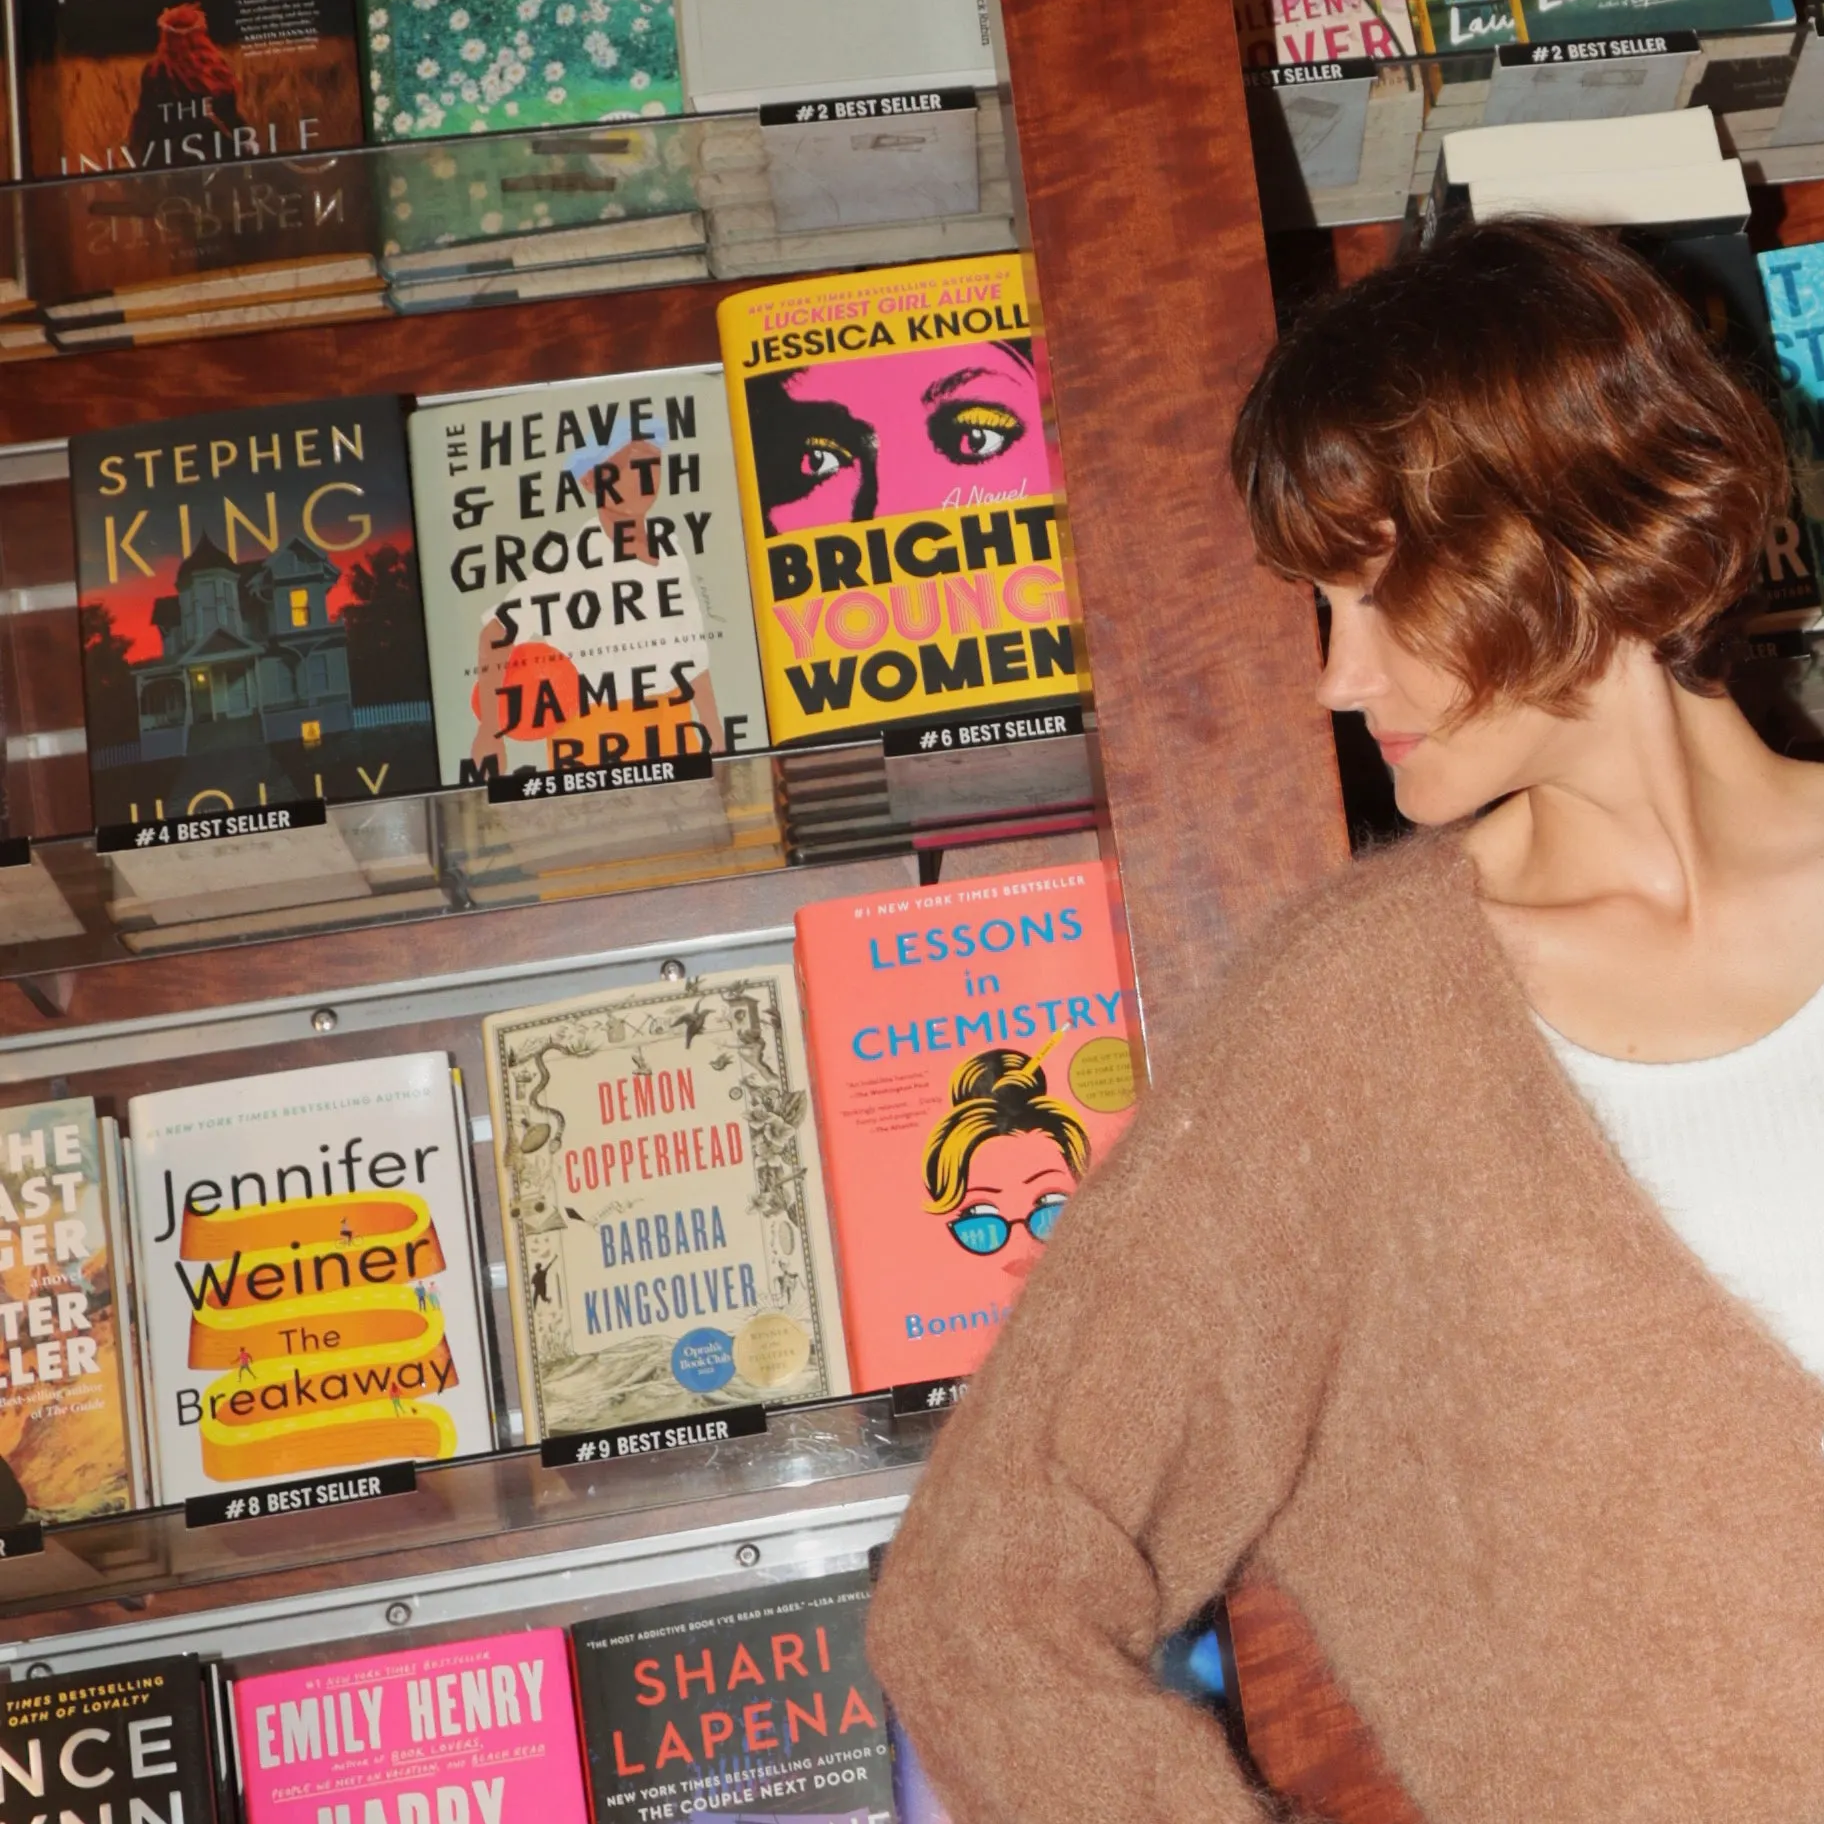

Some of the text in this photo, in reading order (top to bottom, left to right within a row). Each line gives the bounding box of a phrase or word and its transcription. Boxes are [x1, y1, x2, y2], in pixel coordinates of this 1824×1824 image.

[834, 97, 883, 119] BEST
[884, 93, 942, 117] SELLER
[741, 303, 1033, 369] JESSICA KNOLL
[98, 424, 364, 498] STEPHEN
[446, 394, 697, 478] THE HEAVEN
[451, 453, 703, 531] & EARTH
[102, 480, 374, 584] KING
[449, 510, 712, 594] GROCERY
[772, 506, 1057, 602] BRIGHT
[494, 576, 685, 648] STORE
[773, 566, 1069, 661] YOUNG
[493, 658, 696, 740] JAMES
[783, 626, 1076, 716] WOMEN
[959, 724, 1004, 746] BEST
[1008, 715, 1068, 741] SELLER
[867, 909, 1086, 973] LESSONS
[963, 968, 1001, 999] in
[852, 992, 1124, 1064] CHEMISTRY
[598, 1067, 696, 1120] DEMON
[152, 1136, 440, 1242] Jennifer
[563, 1120, 746, 1194] COPPERHEAD
[600, 1205, 727, 1266] BARBARA
[172, 1235, 432, 1313] Weiner
[582, 1266, 758, 1336] KINGSOLVER
[277, 1325, 343, 1356] The
[175, 1354, 456, 1428] Breakaway
[617, 1431, 664, 1455] BEST
[664, 1421, 729, 1449] SELLER
[633, 1632, 834, 1707] SHARI
[256, 1658, 547, 1770] EMILY HENRY
[611, 1692, 877, 1779] LAPENA
[637, 1766, 868, 1823] THE COUPLE NEXT DOOR
